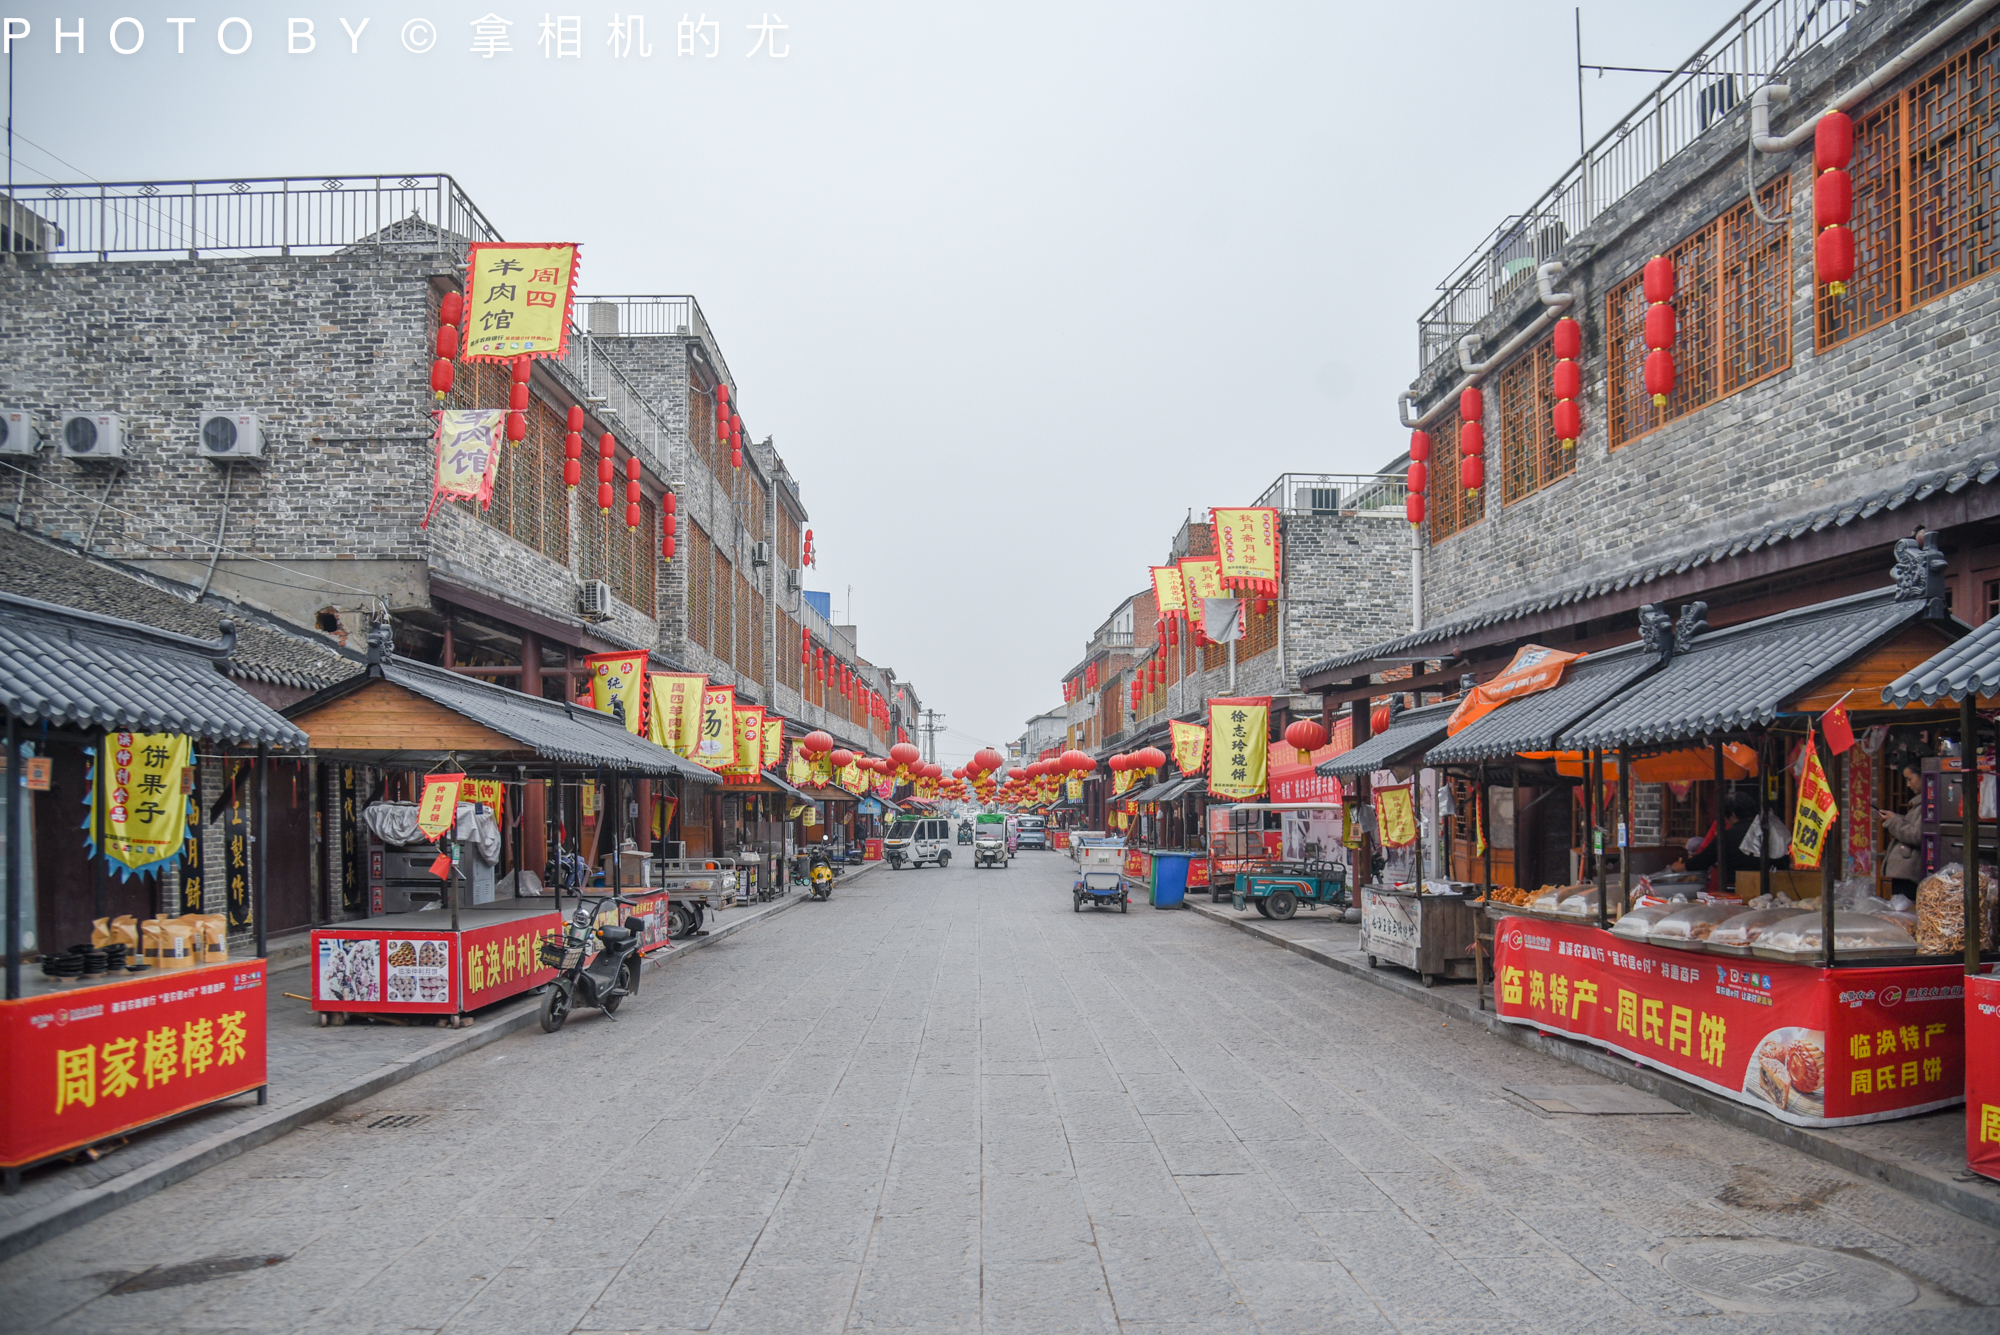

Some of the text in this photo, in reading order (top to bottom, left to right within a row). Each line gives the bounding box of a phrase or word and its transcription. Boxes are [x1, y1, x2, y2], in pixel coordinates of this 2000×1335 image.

[479, 258, 525, 331] 羊肉馆
[526, 267, 560, 308] 周四
[1239, 514, 1257, 564] 秋月斋月饼
[667, 682, 685, 741] 周四羊肉馆
[1230, 709, 1248, 782] 徐志玲烧饼
[429, 785, 446, 823] 仲利月饼
[462, 783, 477, 804] 果
[55, 1010, 247, 1116] 周家棒棒茶
[1849, 1023, 1947, 1060] 临涣特产
[1850, 1056, 1942, 1096] 周氏月饼
